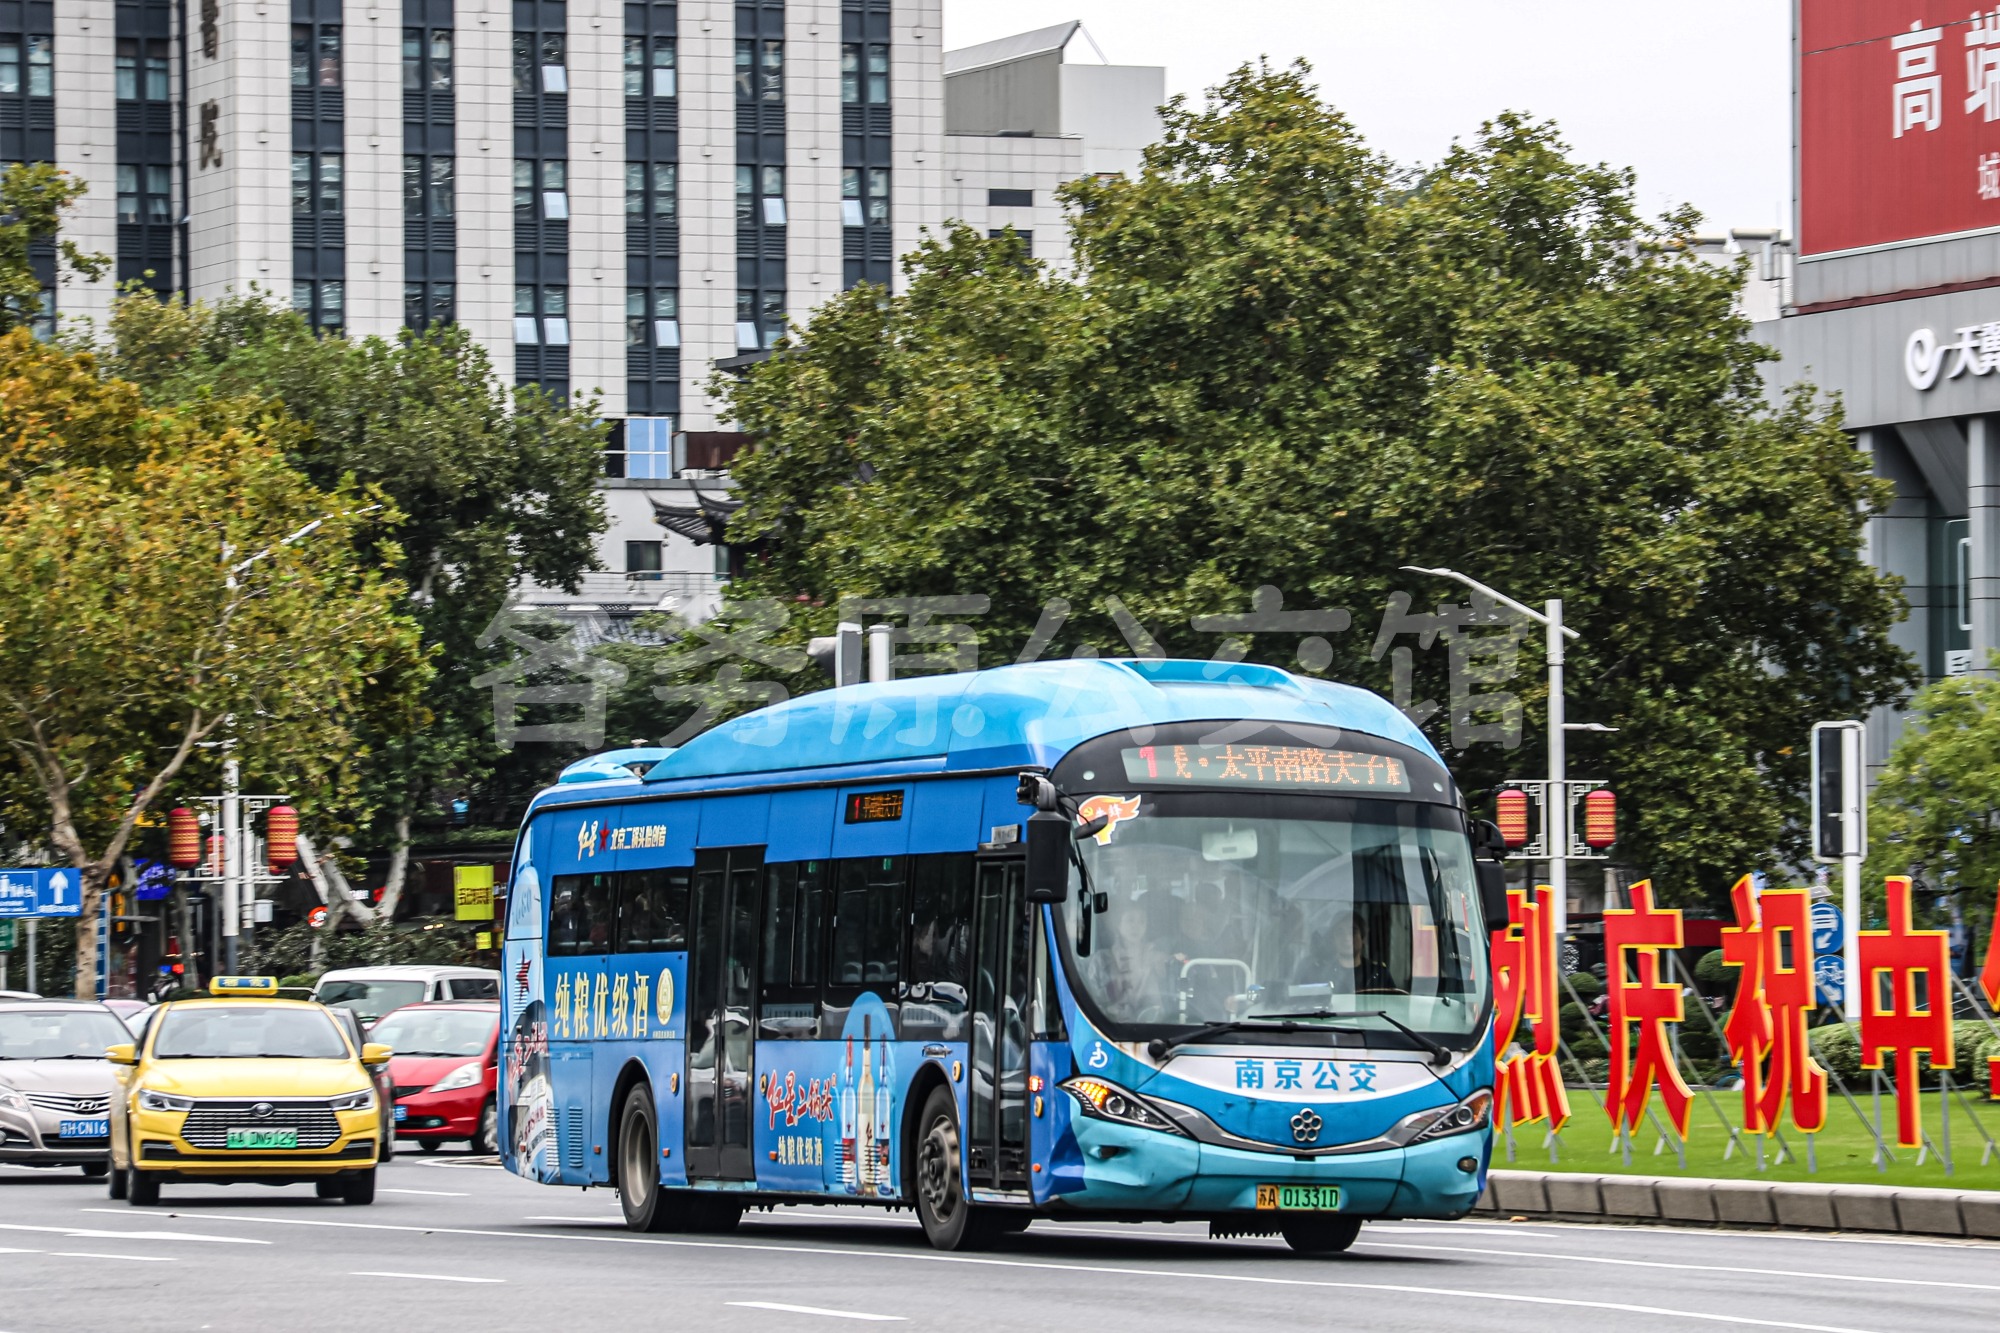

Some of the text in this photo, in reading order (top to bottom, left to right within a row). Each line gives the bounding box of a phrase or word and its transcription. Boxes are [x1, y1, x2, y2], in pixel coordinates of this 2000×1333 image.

[1138, 746, 1159, 778] 1
[553, 970, 650, 1039] 纯粮优级酒
[1491, 872, 2000, 1149] 烈庆祝中
[1234, 1059, 1377, 1093] 南京公交
[778, 1135, 823, 1166] 纯粮优级酒
